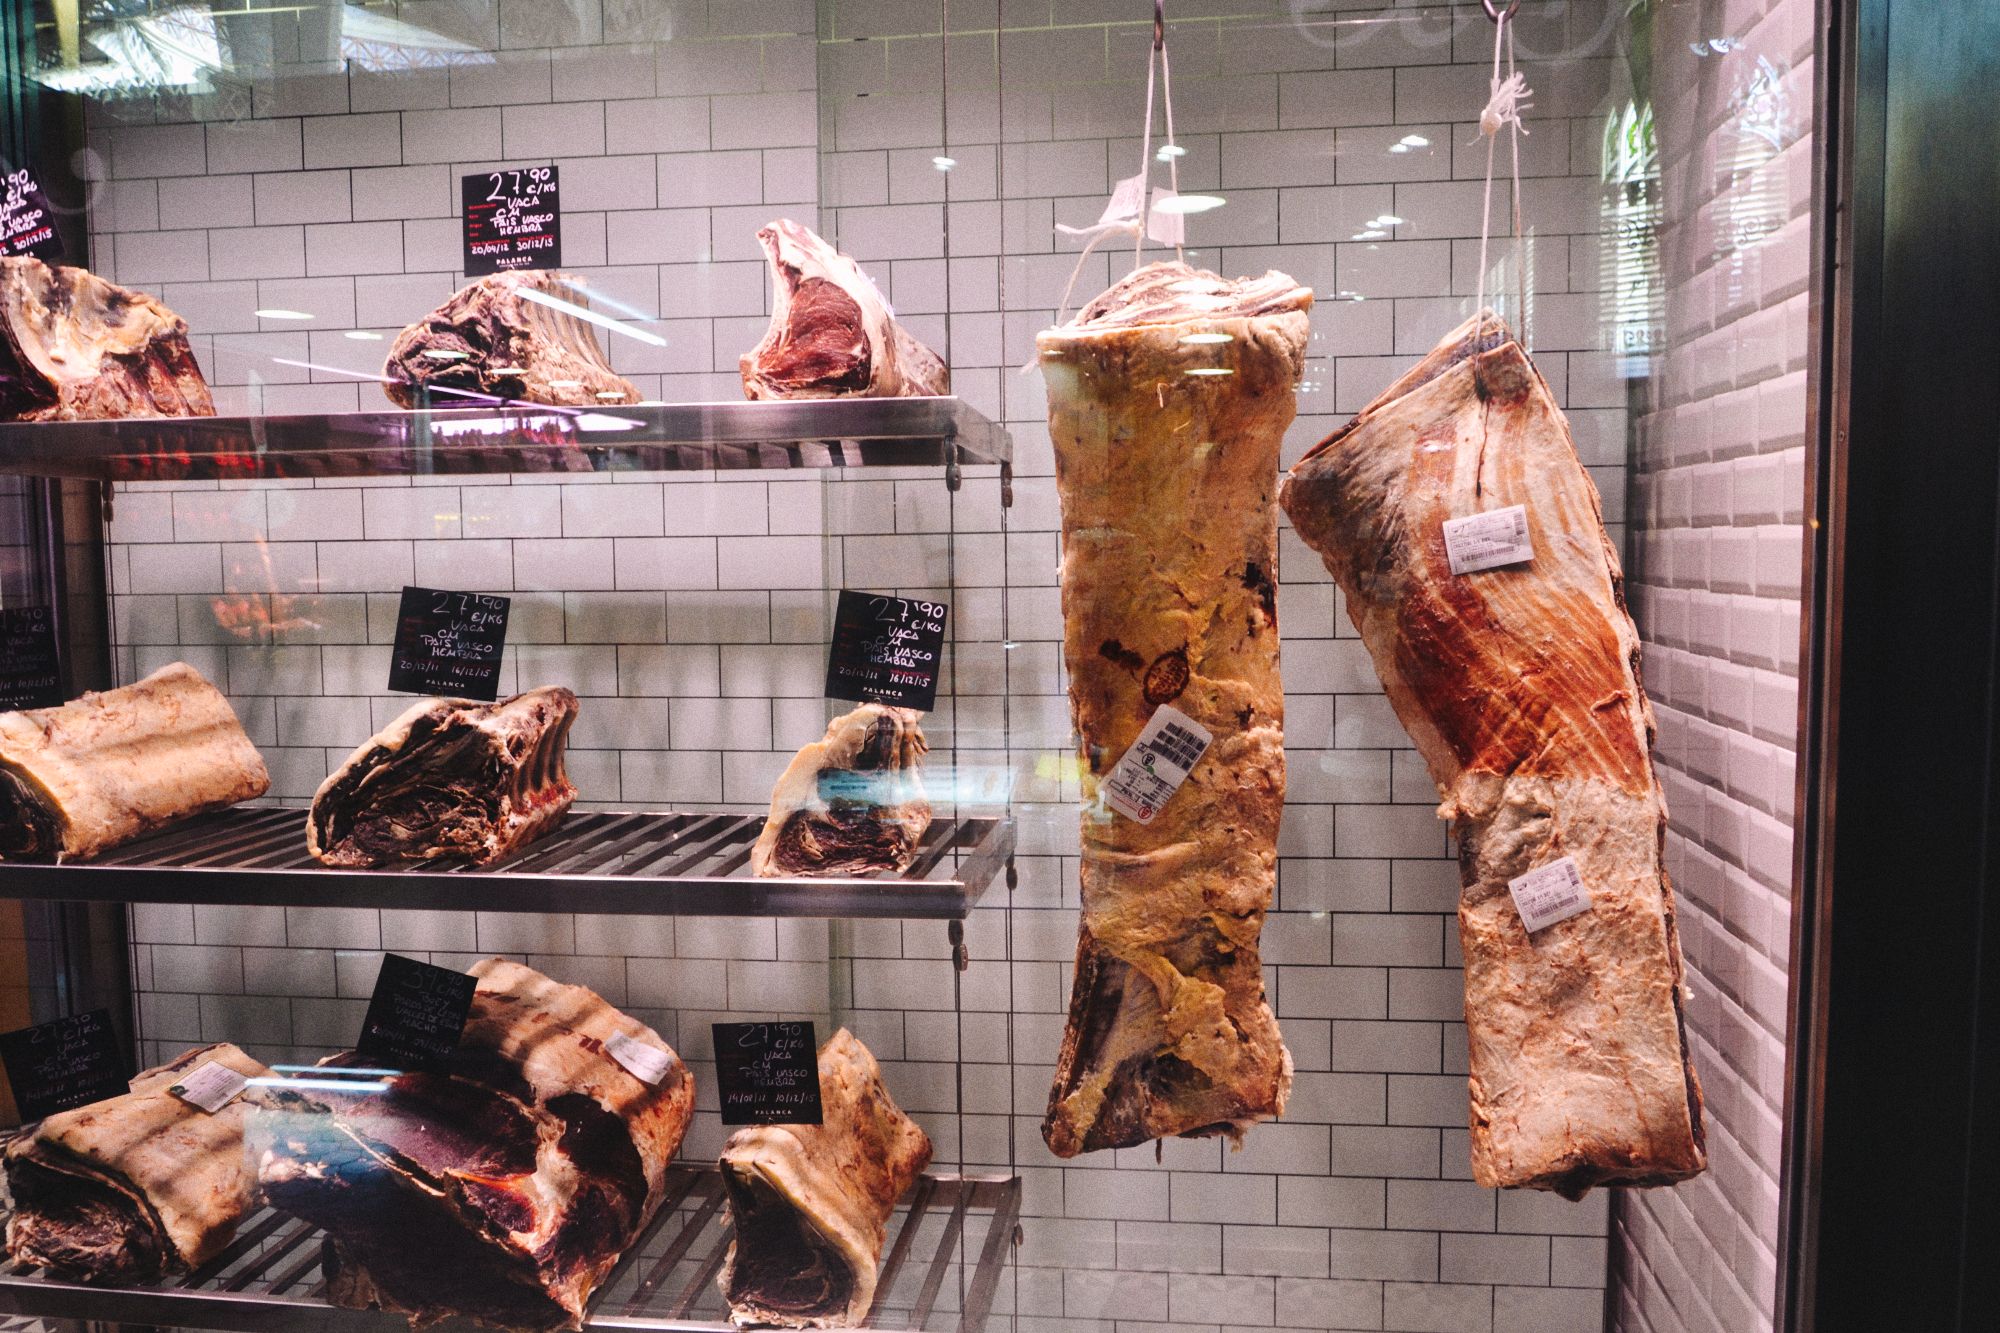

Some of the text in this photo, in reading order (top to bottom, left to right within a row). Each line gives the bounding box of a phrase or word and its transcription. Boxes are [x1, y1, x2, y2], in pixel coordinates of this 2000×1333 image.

[486, 168, 551, 202] 27'90
[507, 196, 540, 209] VACA
[8, 209, 43, 228] VASCO
[495, 207, 520, 218] CM
[489, 216, 516, 228] PAIS
[522, 213, 554, 226] VASCO
[0, 220, 37, 240] EMBRA
[500, 224, 543, 236] HEMBRA
[471, 242, 510, 256] 20/04/12
[516, 236, 554, 252] 30/12/15
[496, 255, 533, 265] PALANCA
[432, 591, 504, 615] 27'90
[869, 597, 944, 623] 27'90
[471, 612, 503, 624] €/KG
[451, 619, 485, 632] VACA
[437, 629, 459, 640] CM
[888, 625, 919, 641] VACA
[420, 634, 452, 648] PAIS
[457, 641, 493, 653] VASCO
[875, 635, 901, 647] CM
[432, 646, 483, 660] HEMBRA
[860, 640, 933, 661] PAIS VASCO
[870, 655, 916, 668] HEMBRA
[400, 660, 492, 678] 20/12/11 16/12/15
[425, 679, 465, 688] PALANCA
[889, 673, 931, 687] 16/12/15
[863, 686, 903, 697] PALANCA
[399, 1017, 438, 1033] MACHO
[738, 1024, 801, 1047] 27'90
[764, 1051, 792, 1062] VACA
[752, 1060, 771, 1070] CM
[776, 1069, 808, 1078] VASCO
